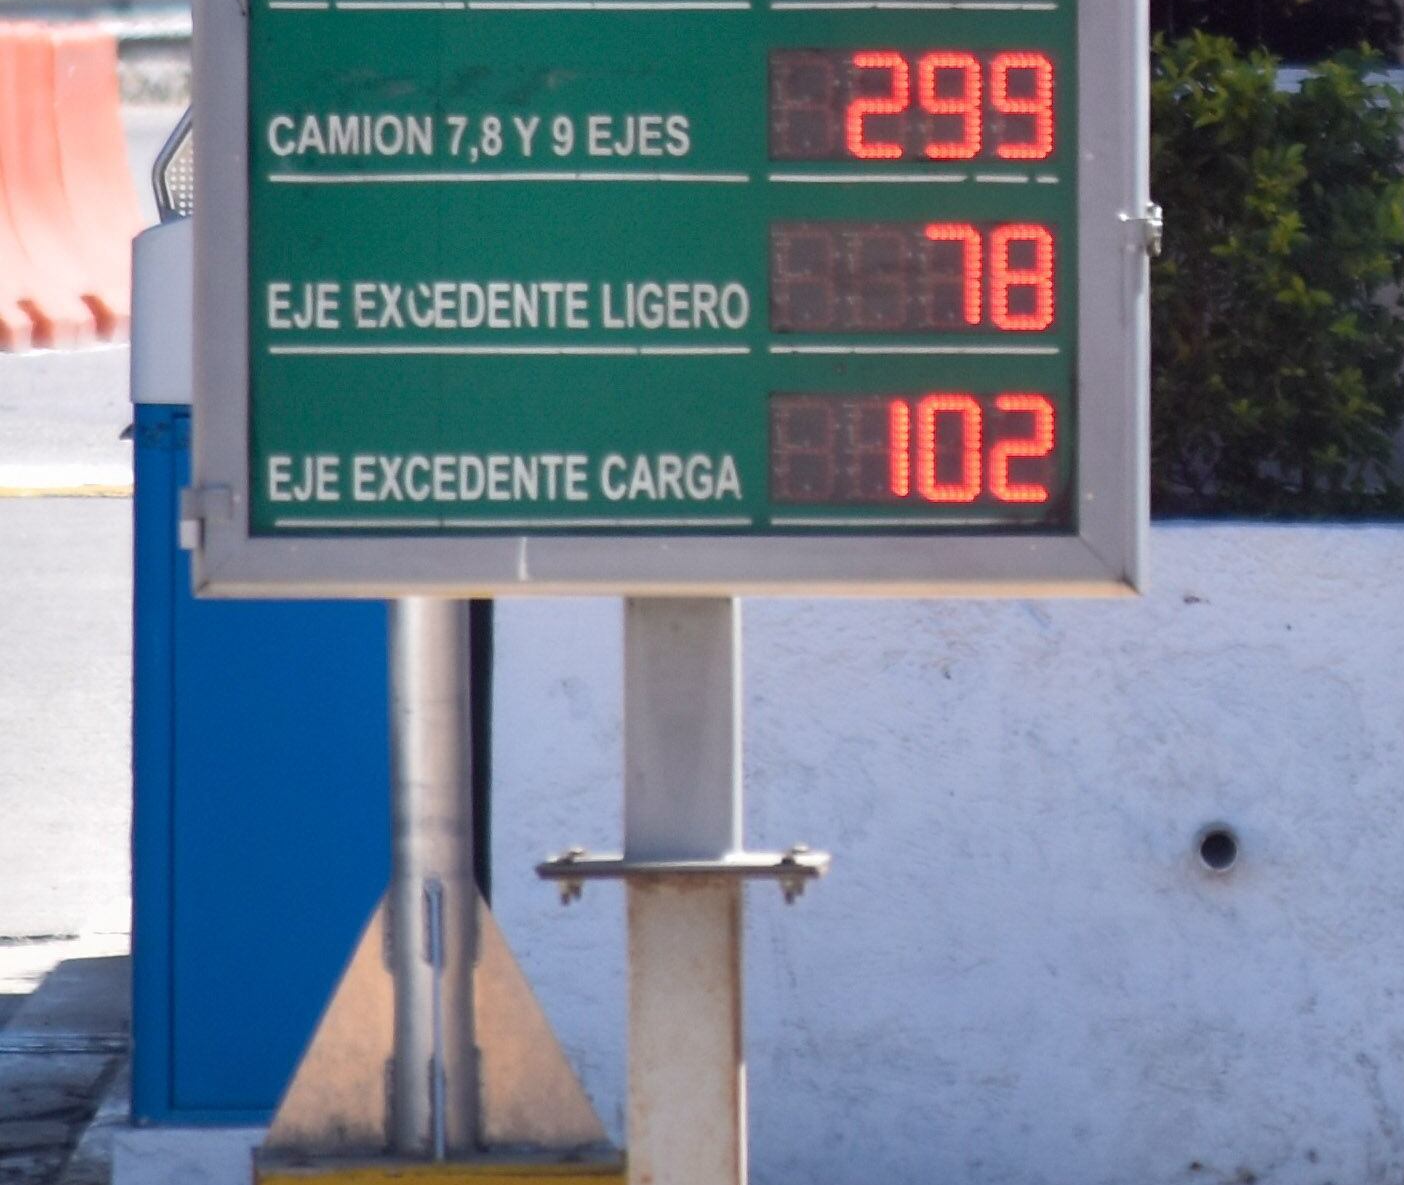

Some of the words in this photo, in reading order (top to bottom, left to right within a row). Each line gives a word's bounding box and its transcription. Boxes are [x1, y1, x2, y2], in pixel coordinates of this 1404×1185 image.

[268, 114, 435, 159] CAMION
[446, 115, 505, 164] 7,8
[513, 116, 542, 158] Y
[552, 115, 576, 158] 9
[588, 114, 692, 159] EJES
[847, 52, 1055, 161] 299
[268, 282, 342, 331] EJE
[353, 281, 591, 331] EXCEDENTE
[602, 282, 751, 331] LIGERO
[926, 224, 1056, 333] 78
[268, 455, 342, 503] EJE
[352, 453, 591, 504] EXCEDENTE
[600, 453, 744, 503] CARGA
[890, 394, 1057, 505] 102
